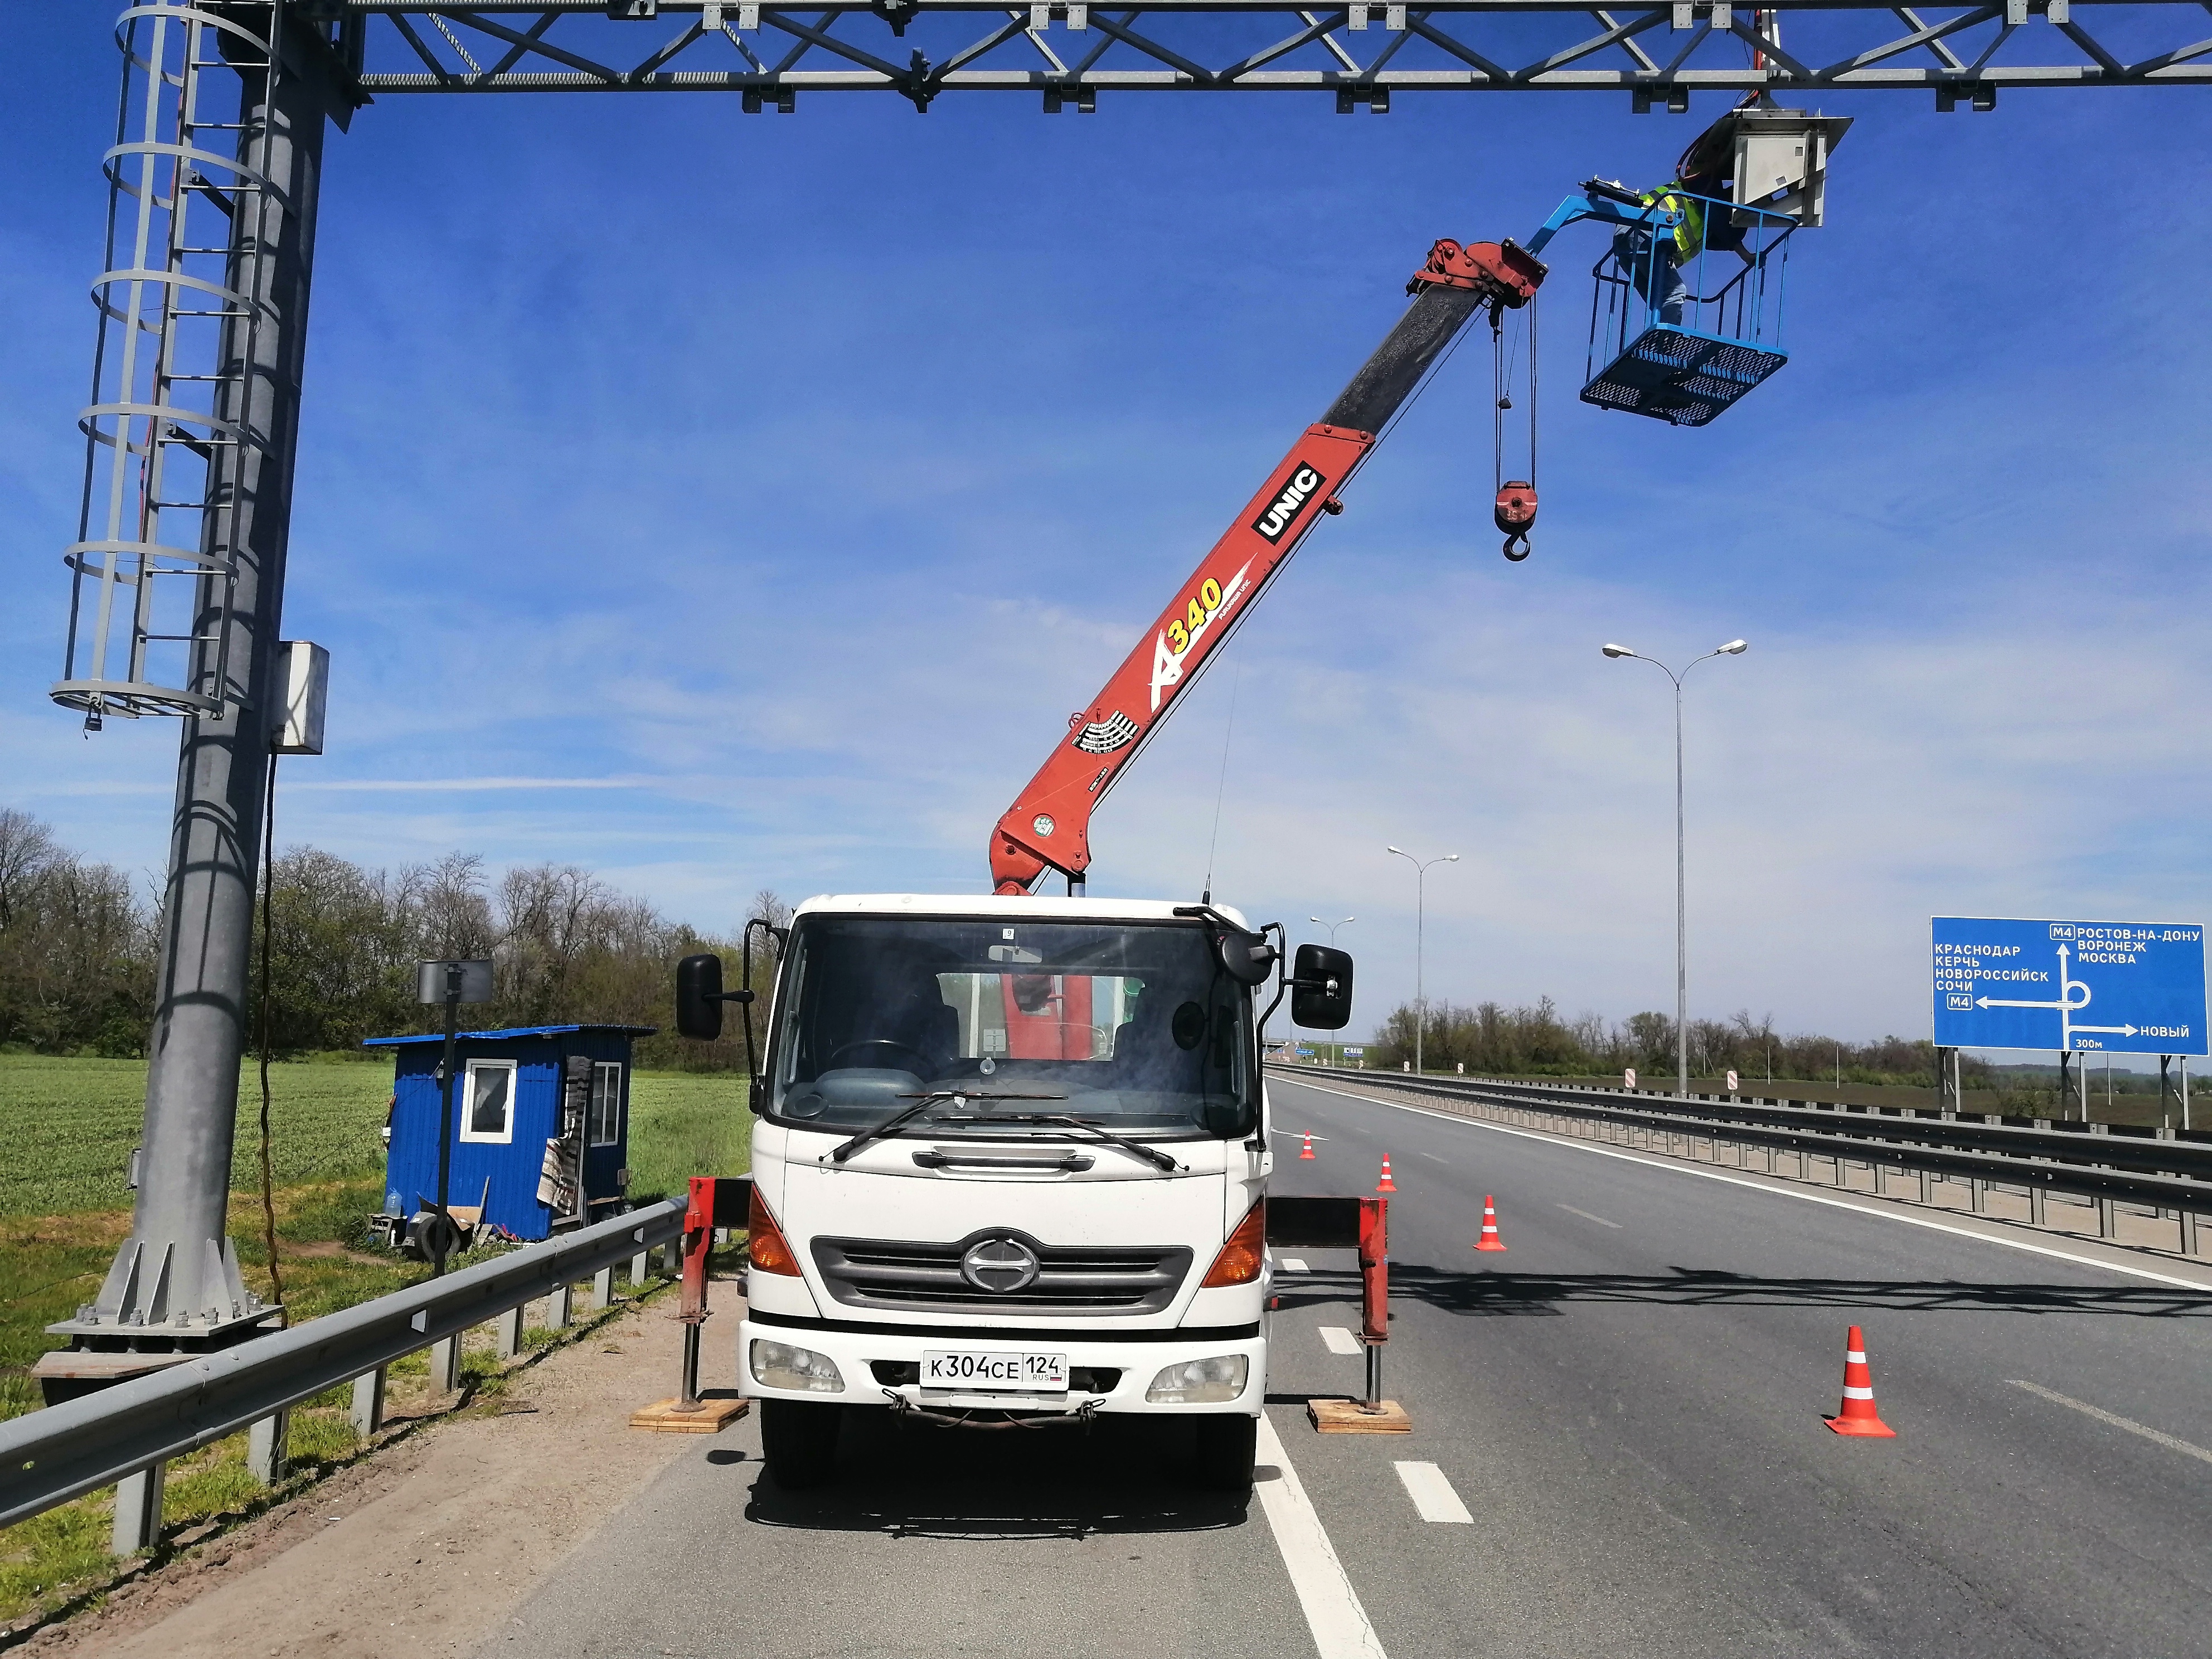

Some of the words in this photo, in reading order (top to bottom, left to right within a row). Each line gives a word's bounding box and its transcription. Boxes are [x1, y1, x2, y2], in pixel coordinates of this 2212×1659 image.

[1259, 469, 1317, 536] UNIC
[2077, 928, 2200, 942] РОСТОВ-НА-ДОНУ
[1936, 944, 2020, 957] КРАСНОДАР
[2078, 941, 2146, 952] ВОРОНЕЖ
[1936, 957, 1980, 967] КЕРЧЬ
[2078, 953, 2136, 964] МОСКВА
[1936, 968, 2049, 982] НОВОРОССИЙСК
[1936, 981, 1973, 991] СОЧИ
[2140, 1025, 2190, 1037] НОВЫЙ
[2075, 1039, 2103, 1049] 300м
